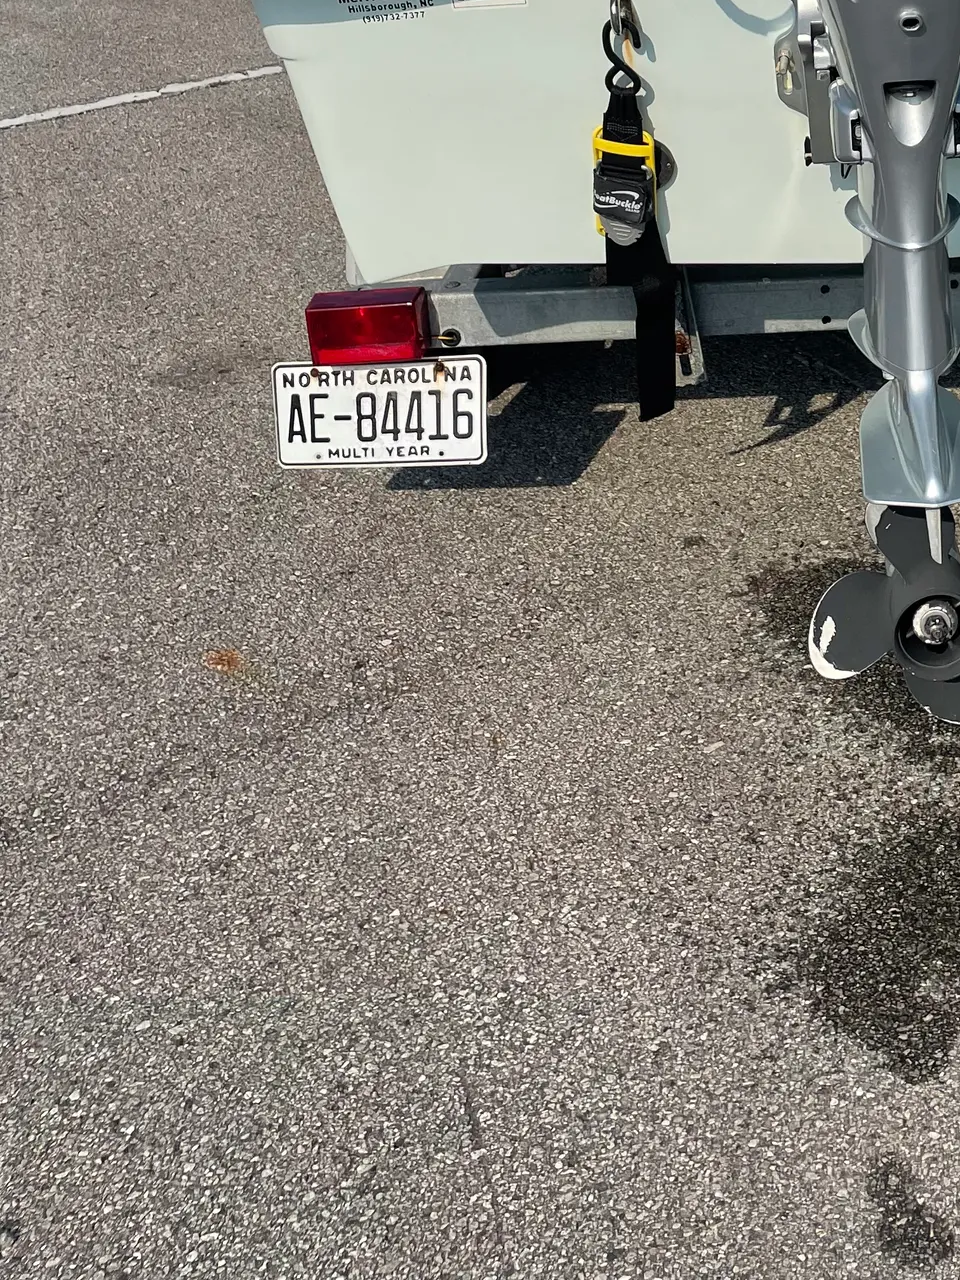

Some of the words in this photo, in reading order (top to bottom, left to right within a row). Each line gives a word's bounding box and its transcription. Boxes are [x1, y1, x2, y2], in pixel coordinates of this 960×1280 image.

[348, 1, 417, 13] Hillsborough,
[362, 11, 425, 24] (919)732-7377
[283, 370, 355, 388] NORTH
[367, 365, 472, 386] CAROLINA
[288, 389, 473, 443] AE-84416
[328, 447, 375, 459] MULTI
[386, 445, 430, 457] YEAR
